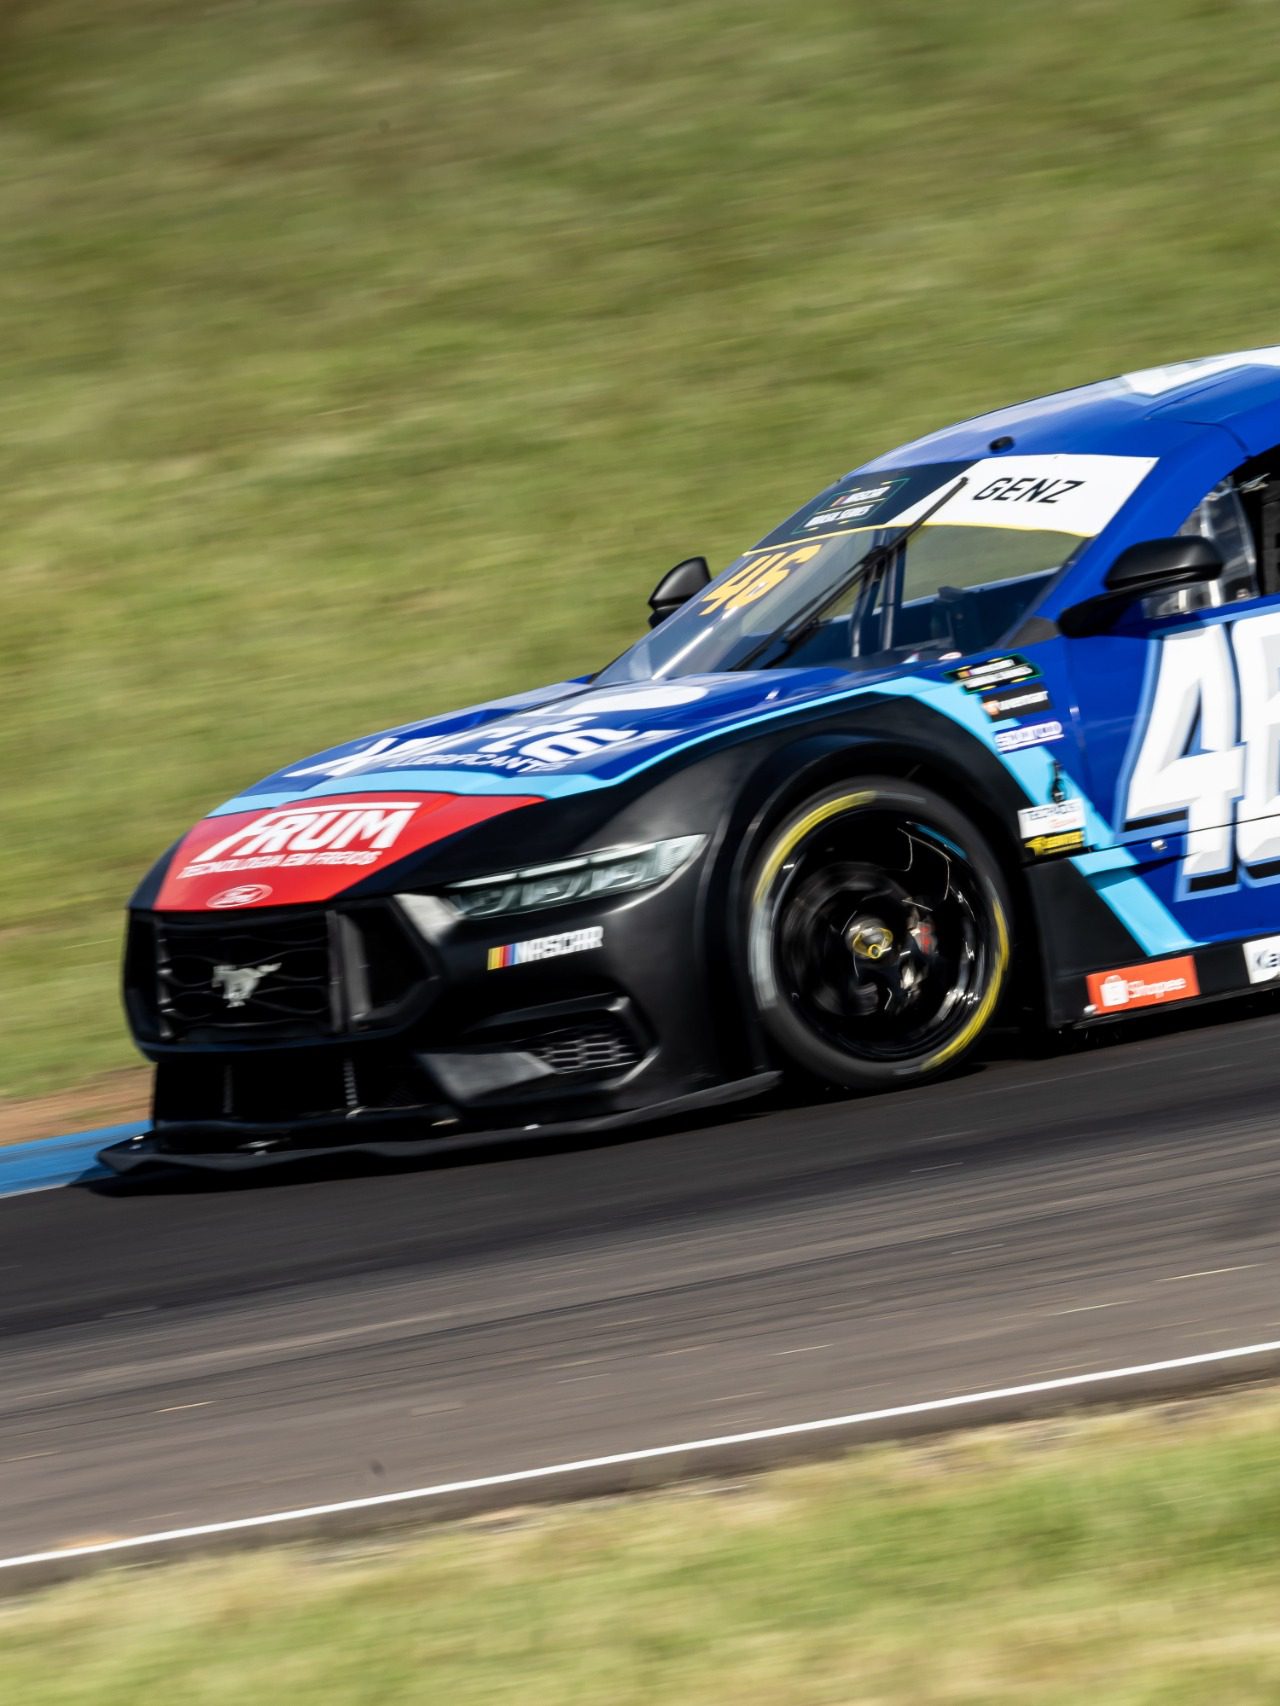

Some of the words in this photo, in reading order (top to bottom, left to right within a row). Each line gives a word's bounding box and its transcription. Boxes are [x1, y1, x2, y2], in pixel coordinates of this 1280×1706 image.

[973, 478, 1084, 504] GENZ
[699, 544, 822, 616] 46
[191, 801, 422, 863] FRUM
